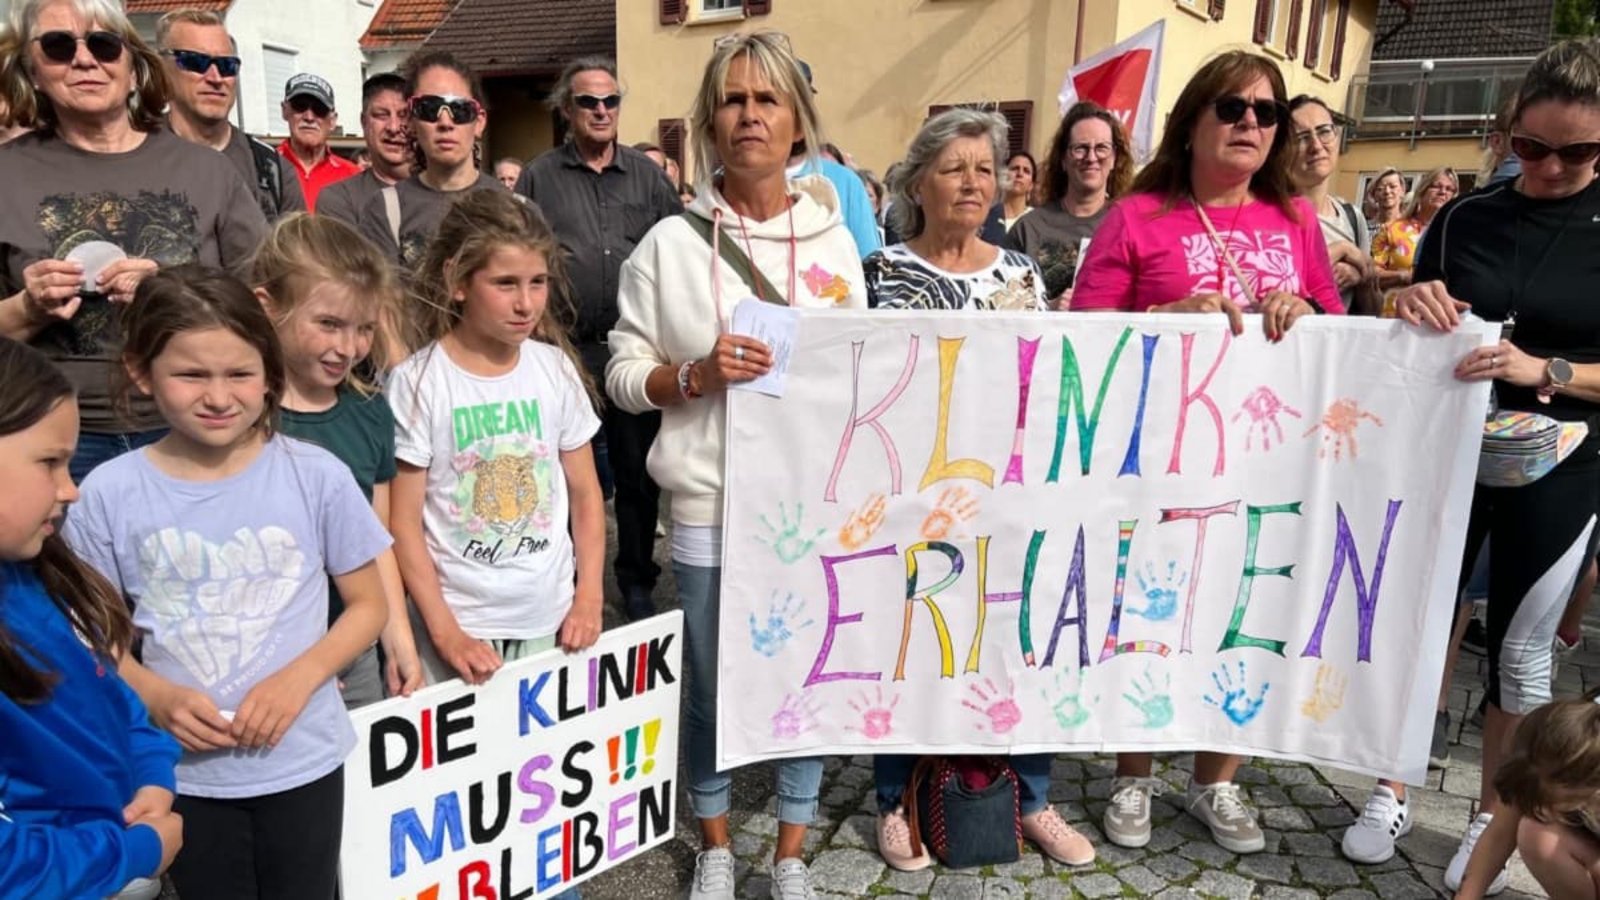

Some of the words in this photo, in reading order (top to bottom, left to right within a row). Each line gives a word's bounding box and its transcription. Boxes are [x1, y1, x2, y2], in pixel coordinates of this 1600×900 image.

[453, 399, 543, 451] DREAM
[824, 326, 1232, 503] KLINIK
[463, 538, 504, 564] Feel
[513, 536, 550, 557] Free
[803, 499, 1403, 687] ERHALTEN
[369, 692, 477, 788] DIE
[518, 633, 676, 737] KLINIK
[458, 779, 672, 900] BLEIBEN
